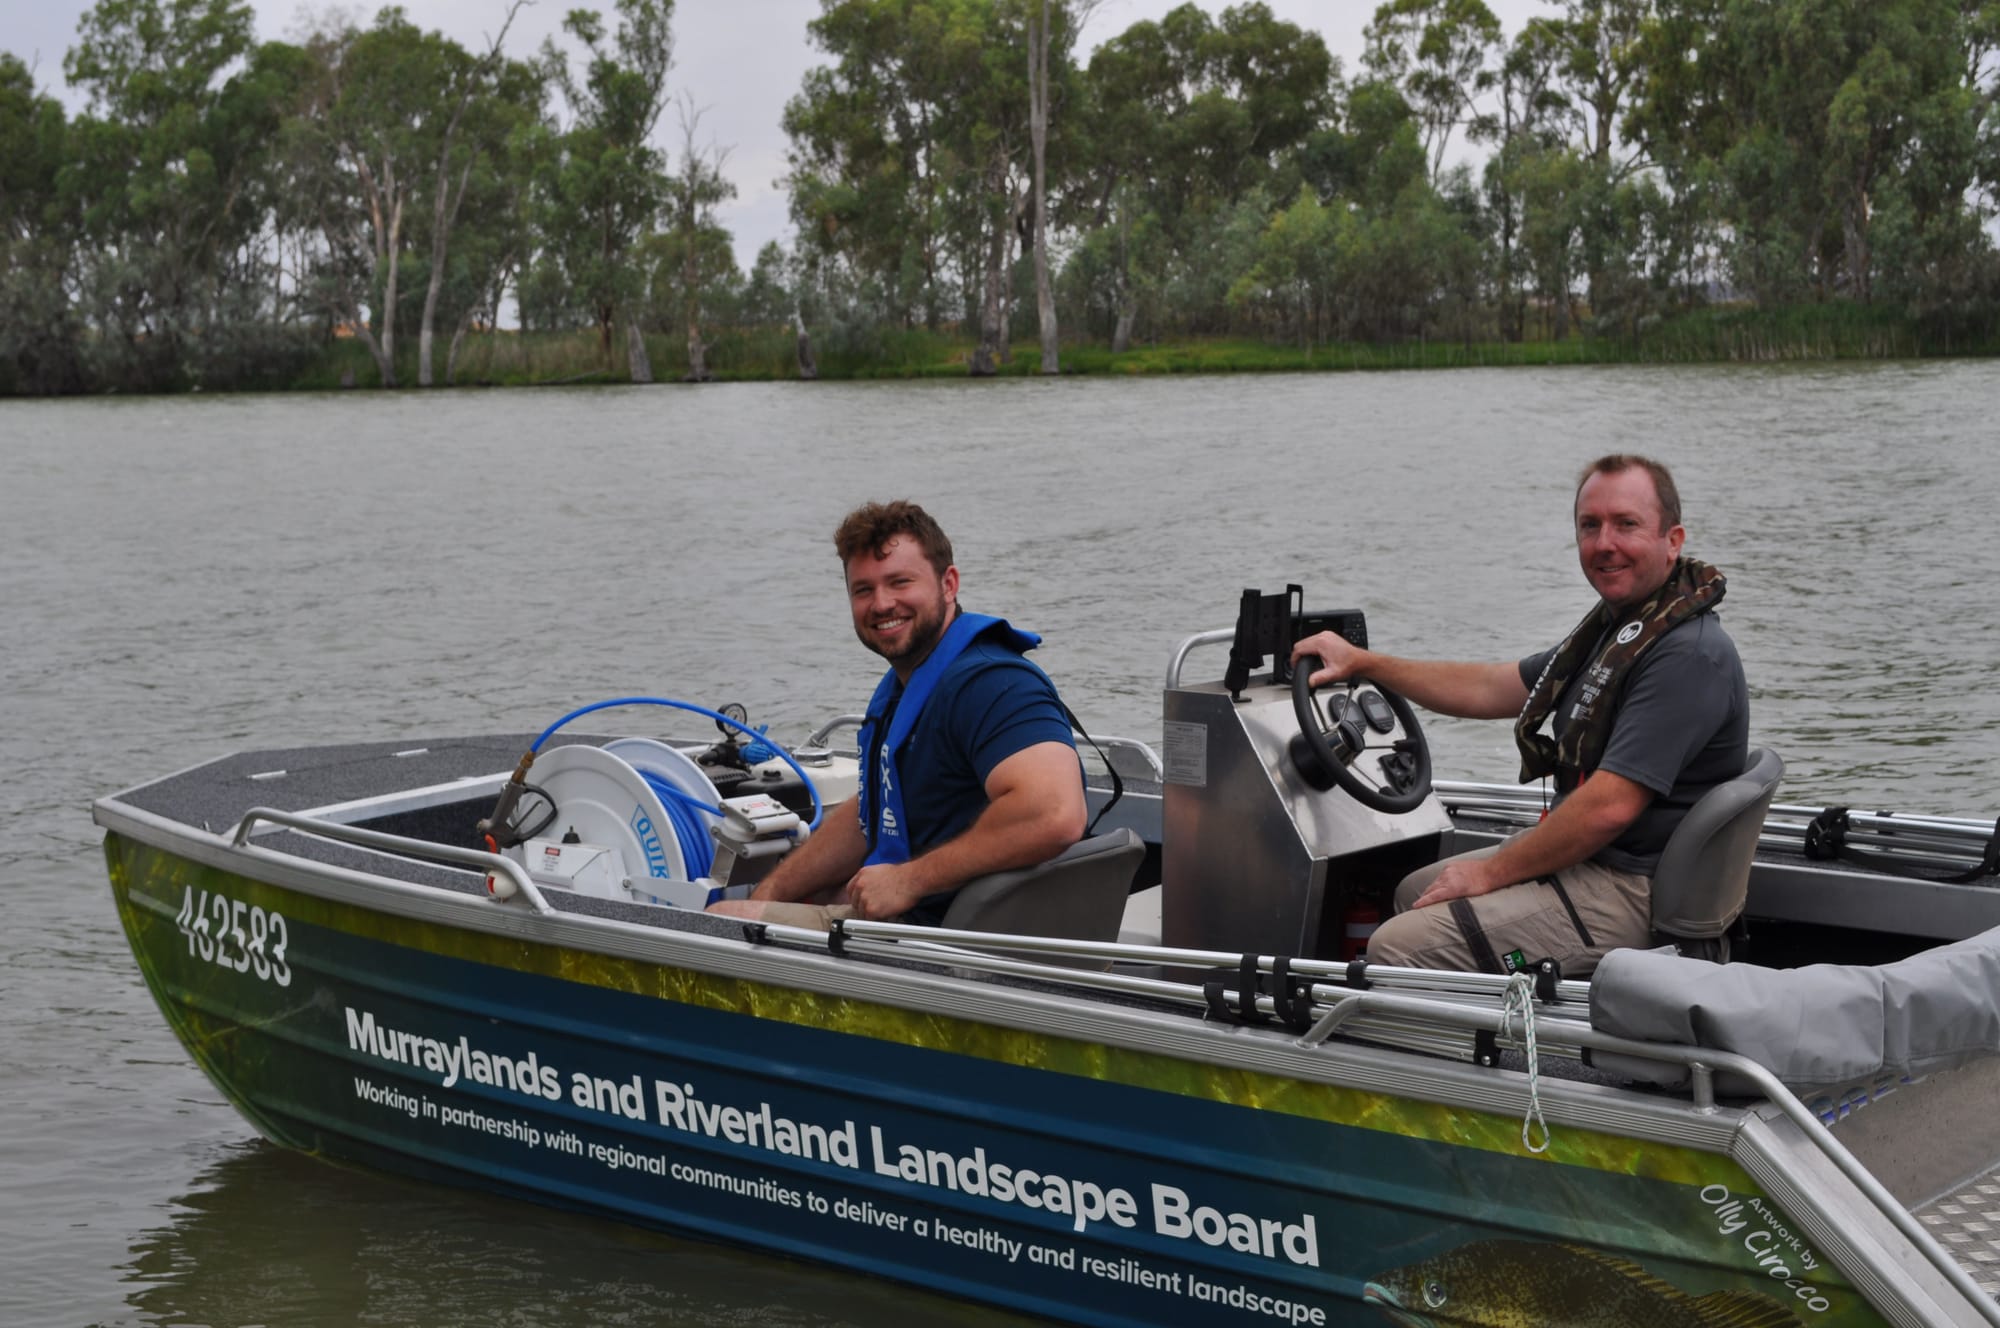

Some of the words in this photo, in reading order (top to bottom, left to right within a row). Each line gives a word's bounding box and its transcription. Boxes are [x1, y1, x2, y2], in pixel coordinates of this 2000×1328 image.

[880, 743, 897, 828] AXIS
[637, 817, 668, 879] QUIK
[175, 884, 291, 988] 462583
[345, 1006, 562, 1101] Murraylands
[571, 1072, 646, 1121] and
[655, 1079, 859, 1169] Riverland
[870, 1125, 1138, 1233] Landscape
[1151, 1183, 1320, 1267] Board
[354, 1077, 418, 1118] Working
[422, 1101, 437, 1118] in
[441, 1106, 540, 1148] partnership
[544, 1132, 583, 1155] with
[588, 1143, 666, 1176] regional
[671, 1163, 802, 1208] communities
[806, 1191, 829, 1214] to
[834, 1197, 908, 1232] deliver
[913, 1219, 928, 1237] a
[935, 1218, 1022, 1263] healthy
[1028, 1245, 1075, 1270] and
[1082, 1256, 1181, 1294] resilient
[1188, 1274, 1326, 1326] landscape
[1700, 1184, 1748, 1235] Olly
[1744, 1230, 1830, 1312] Cirocco
[1748, 1197, 1803, 1252] Artwork
[1800, 1249, 1820, 1271] by
